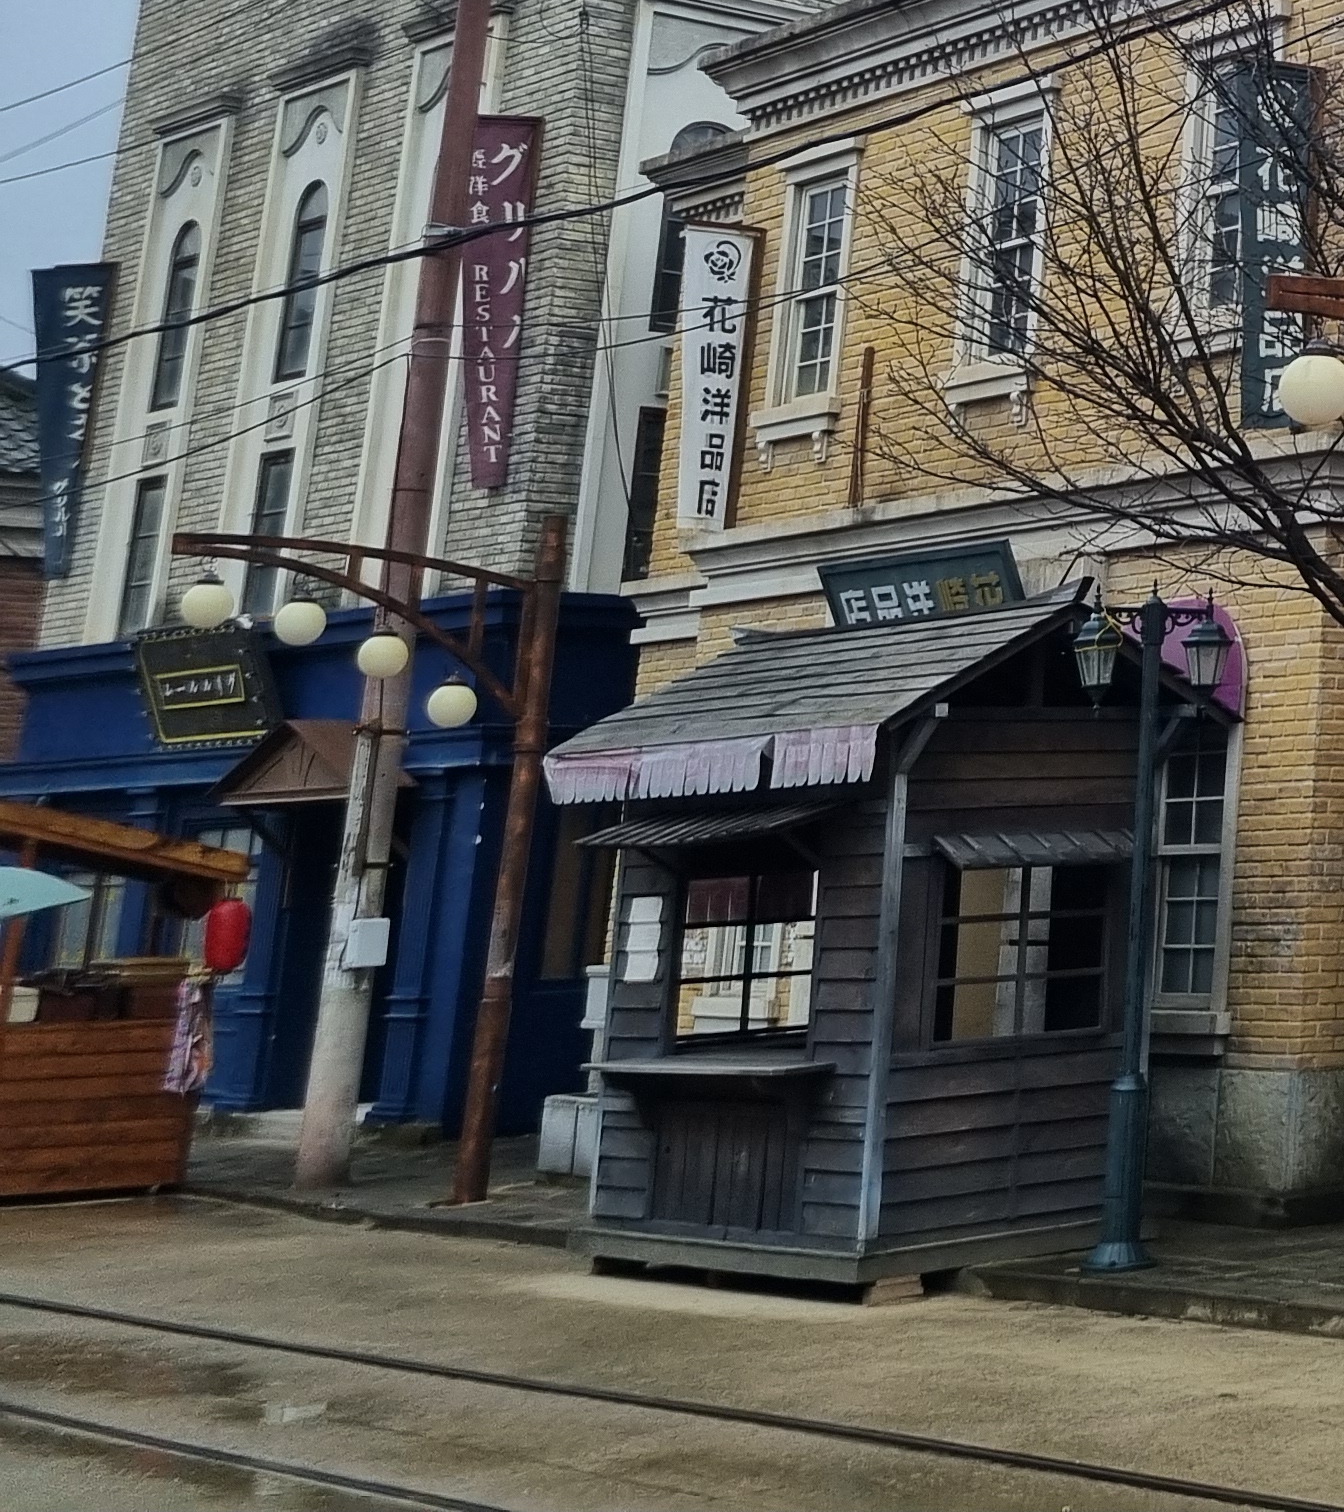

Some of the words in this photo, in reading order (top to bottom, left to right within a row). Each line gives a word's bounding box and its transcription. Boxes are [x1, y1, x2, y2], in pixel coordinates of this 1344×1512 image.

[472, 264, 503, 464] RESTAURANT
[696, 295, 738, 518] 花崎洋品店
